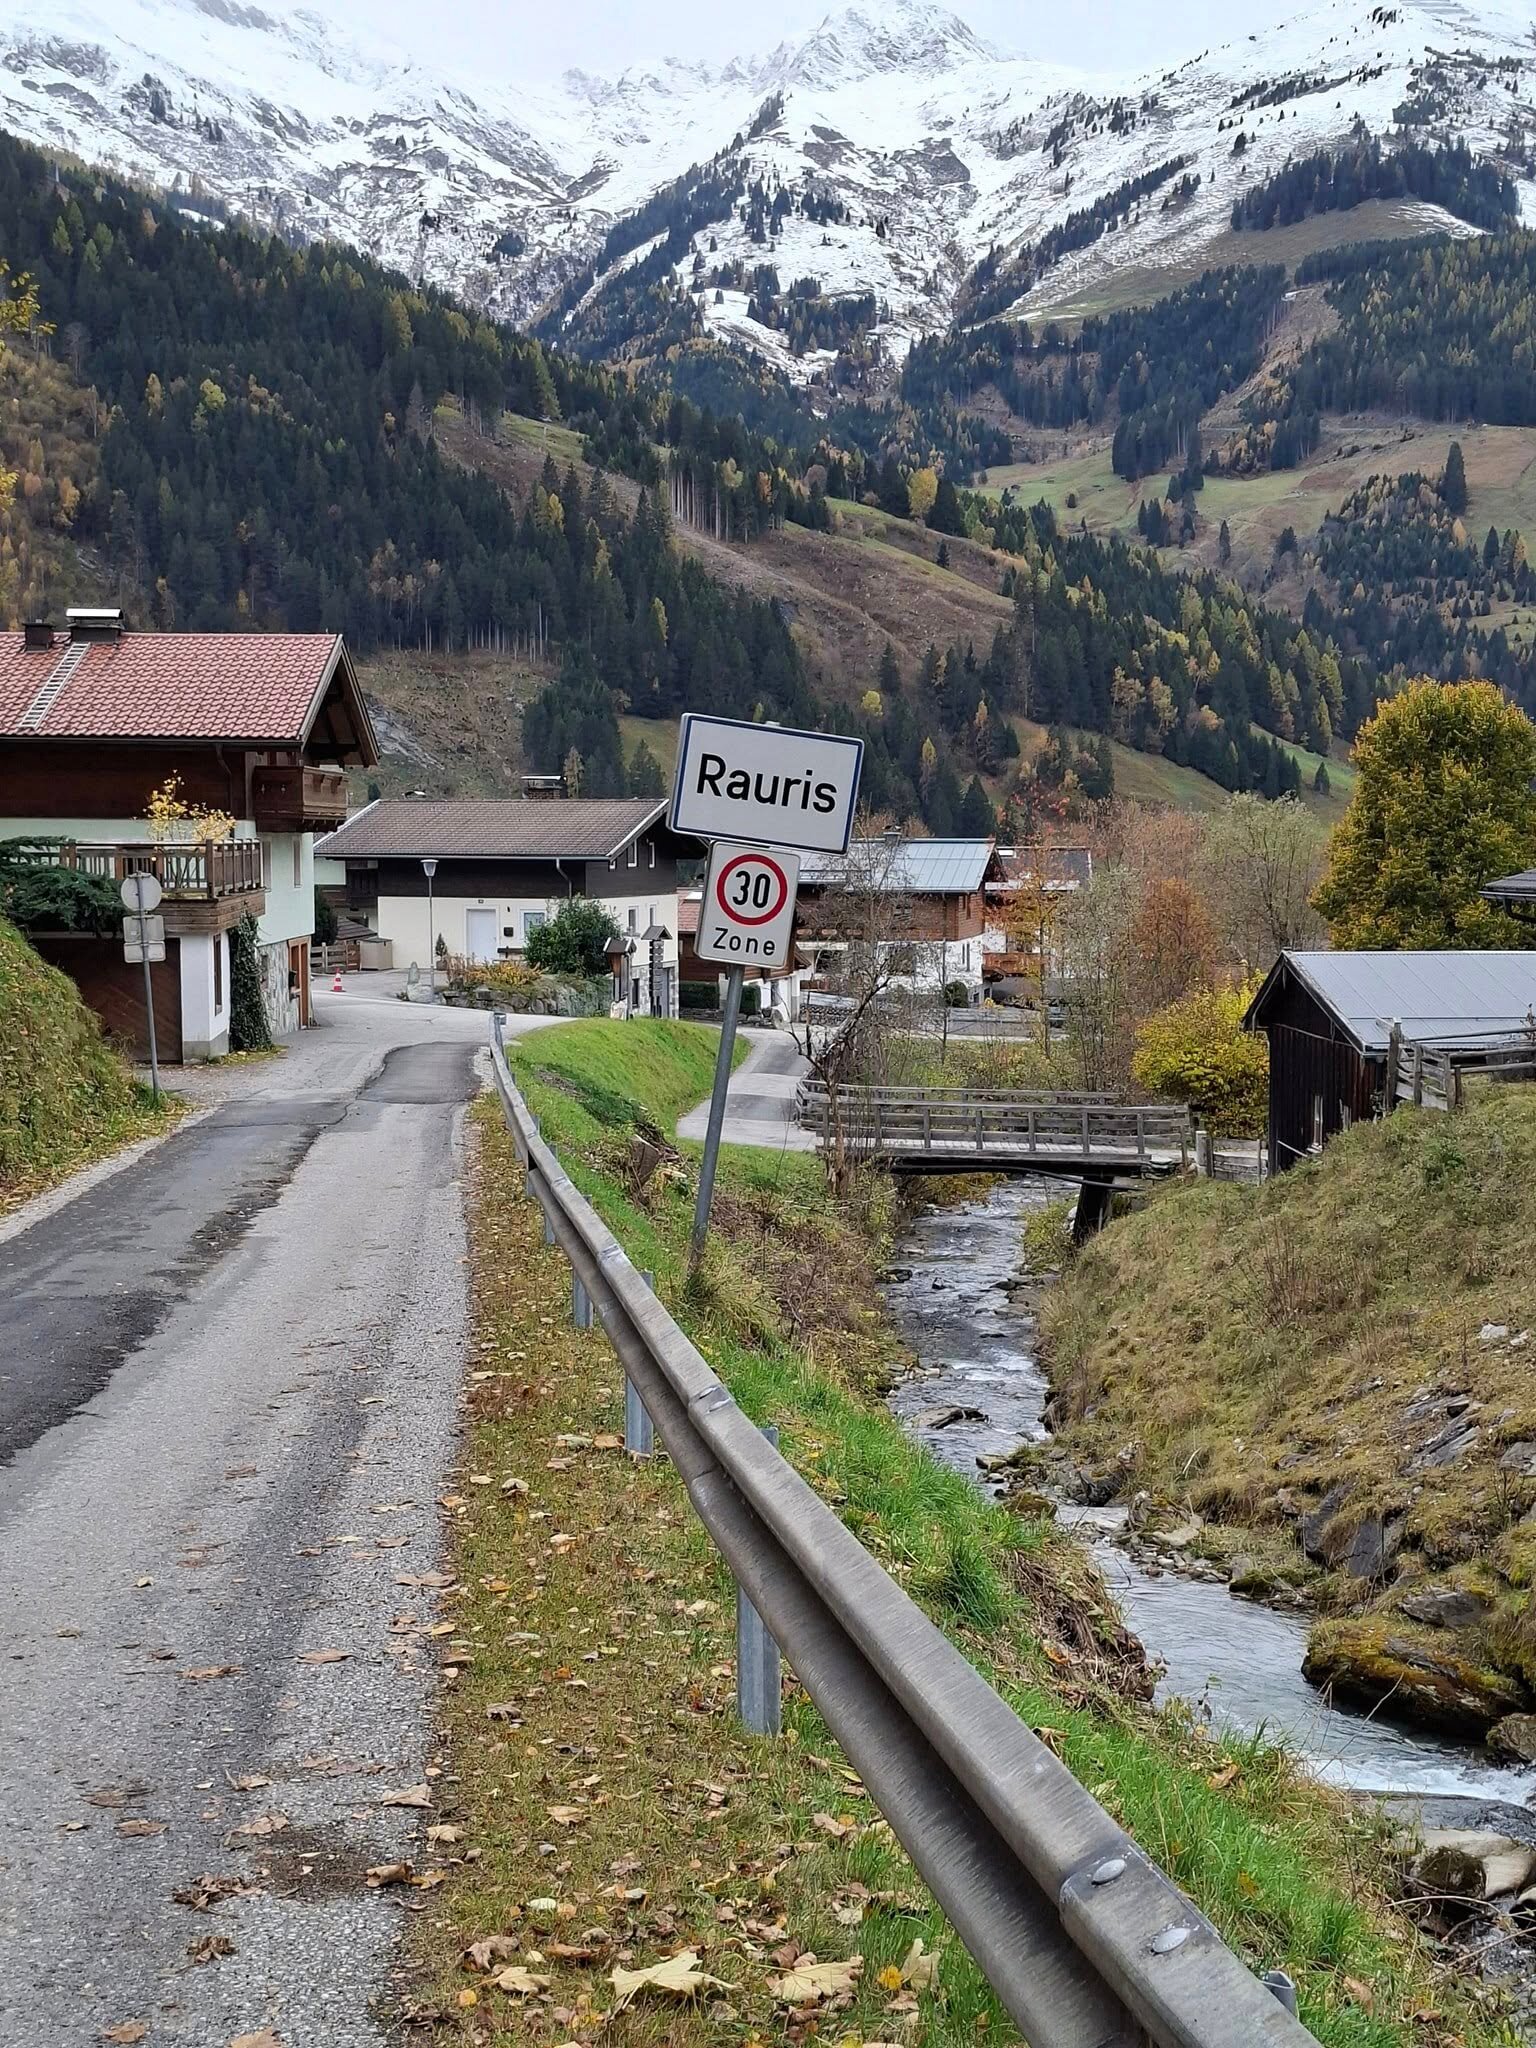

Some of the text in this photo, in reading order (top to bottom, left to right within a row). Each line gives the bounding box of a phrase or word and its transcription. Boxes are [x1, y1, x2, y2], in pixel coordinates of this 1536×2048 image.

[696, 753, 837, 813] Rauris
[732, 870, 771, 908] 30
[713, 927, 775, 955] Zone
